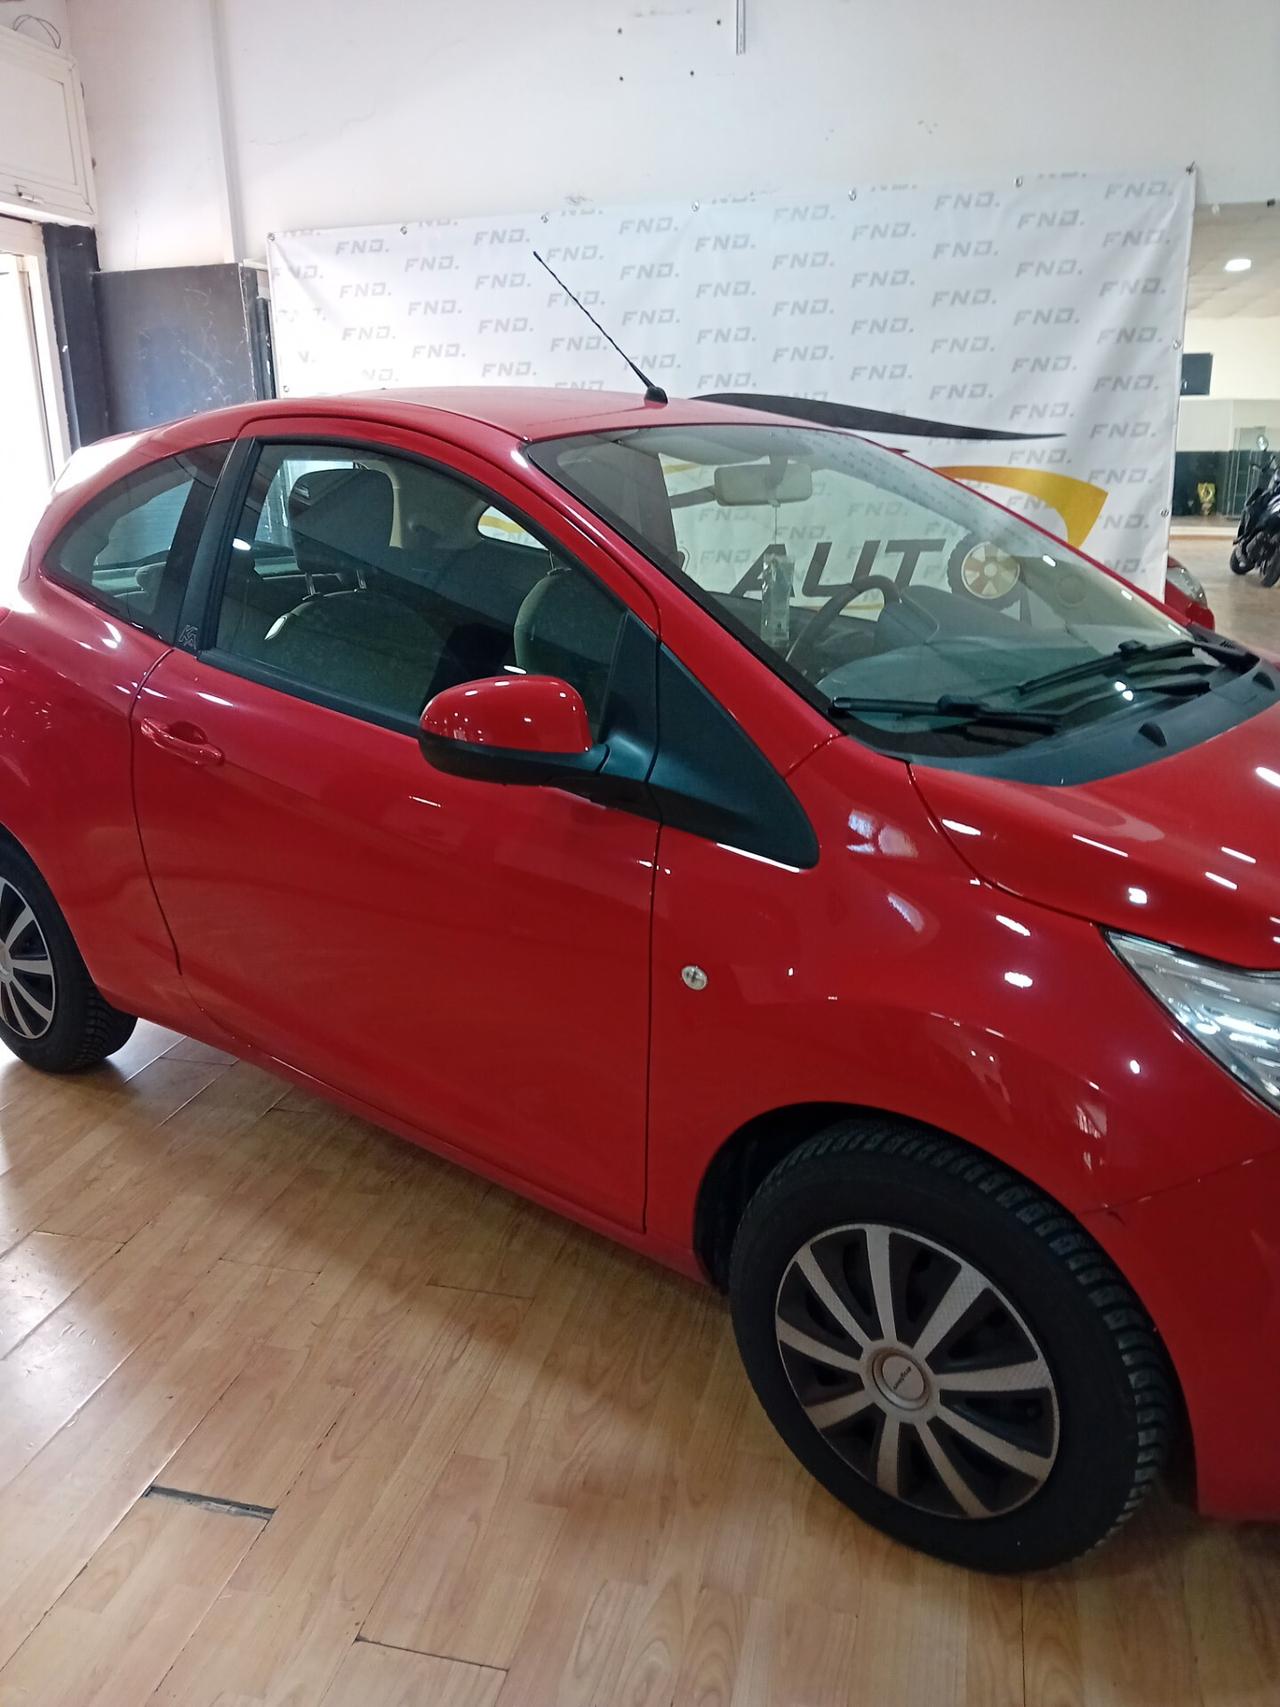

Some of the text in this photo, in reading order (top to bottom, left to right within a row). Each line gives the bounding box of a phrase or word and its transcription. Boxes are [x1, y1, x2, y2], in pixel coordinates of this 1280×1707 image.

[1104, 181, 1173, 199] FND.
[933, 193, 1000, 211] FND.
[773, 204, 836, 223] FND.
[1017, 210, 1085, 229] FND.
[619, 217, 679, 235] FND.
[852, 223, 917, 240] FND.
[473, 228, 531, 246] FND.
[695, 234, 756, 252] FND.
[335, 238, 390, 256] FND.
[546, 245, 604, 262] FND.
[933, 241, 998, 259] FND.
[404, 255, 460, 272] FND.
[772, 252, 835, 270] FND.
[1015, 259, 1083, 278] FND.
[620, 262, 680, 280] FND.
[851, 270, 916, 288] FND.
[339, 282, 392, 299] FND.
[474, 272, 532, 291] FND.
[696, 281, 757, 299] FND.
[548, 290, 606, 308] FND.
[931, 289, 997, 307] FND.
[407, 299, 463, 316] FND.
[772, 299, 834, 317] FND.
[477, 317, 535, 335] FND.
[622, 309, 681, 326] FND.
[1013, 308, 1080, 326] FND.
[341, 325, 396, 341] FND.
[851, 318, 915, 335] FND.
[550, 335, 609, 352] FND.
[696, 327, 757, 345] FND.
[1097, 327, 1163, 345] FND.
[411, 343, 466, 359] FND.
[772, 346, 834, 363] FND.
[931, 337, 995, 354] FND.
[481, 361, 537, 378] FND.
[623, 354, 682, 371] FND.
[1011, 356, 1077, 373] FND.
[696, 373, 757, 390] FND.
[850, 364, 913, 381] FND.
[929, 384, 993, 401] FND.
[1093, 375, 1159, 393] FND.
[1009, 402, 1074, 420] FND.
[1089, 421, 1156, 439] FND.
[1008, 448, 1072, 465] FND.
[1087, 468, 1152, 485] FND.
